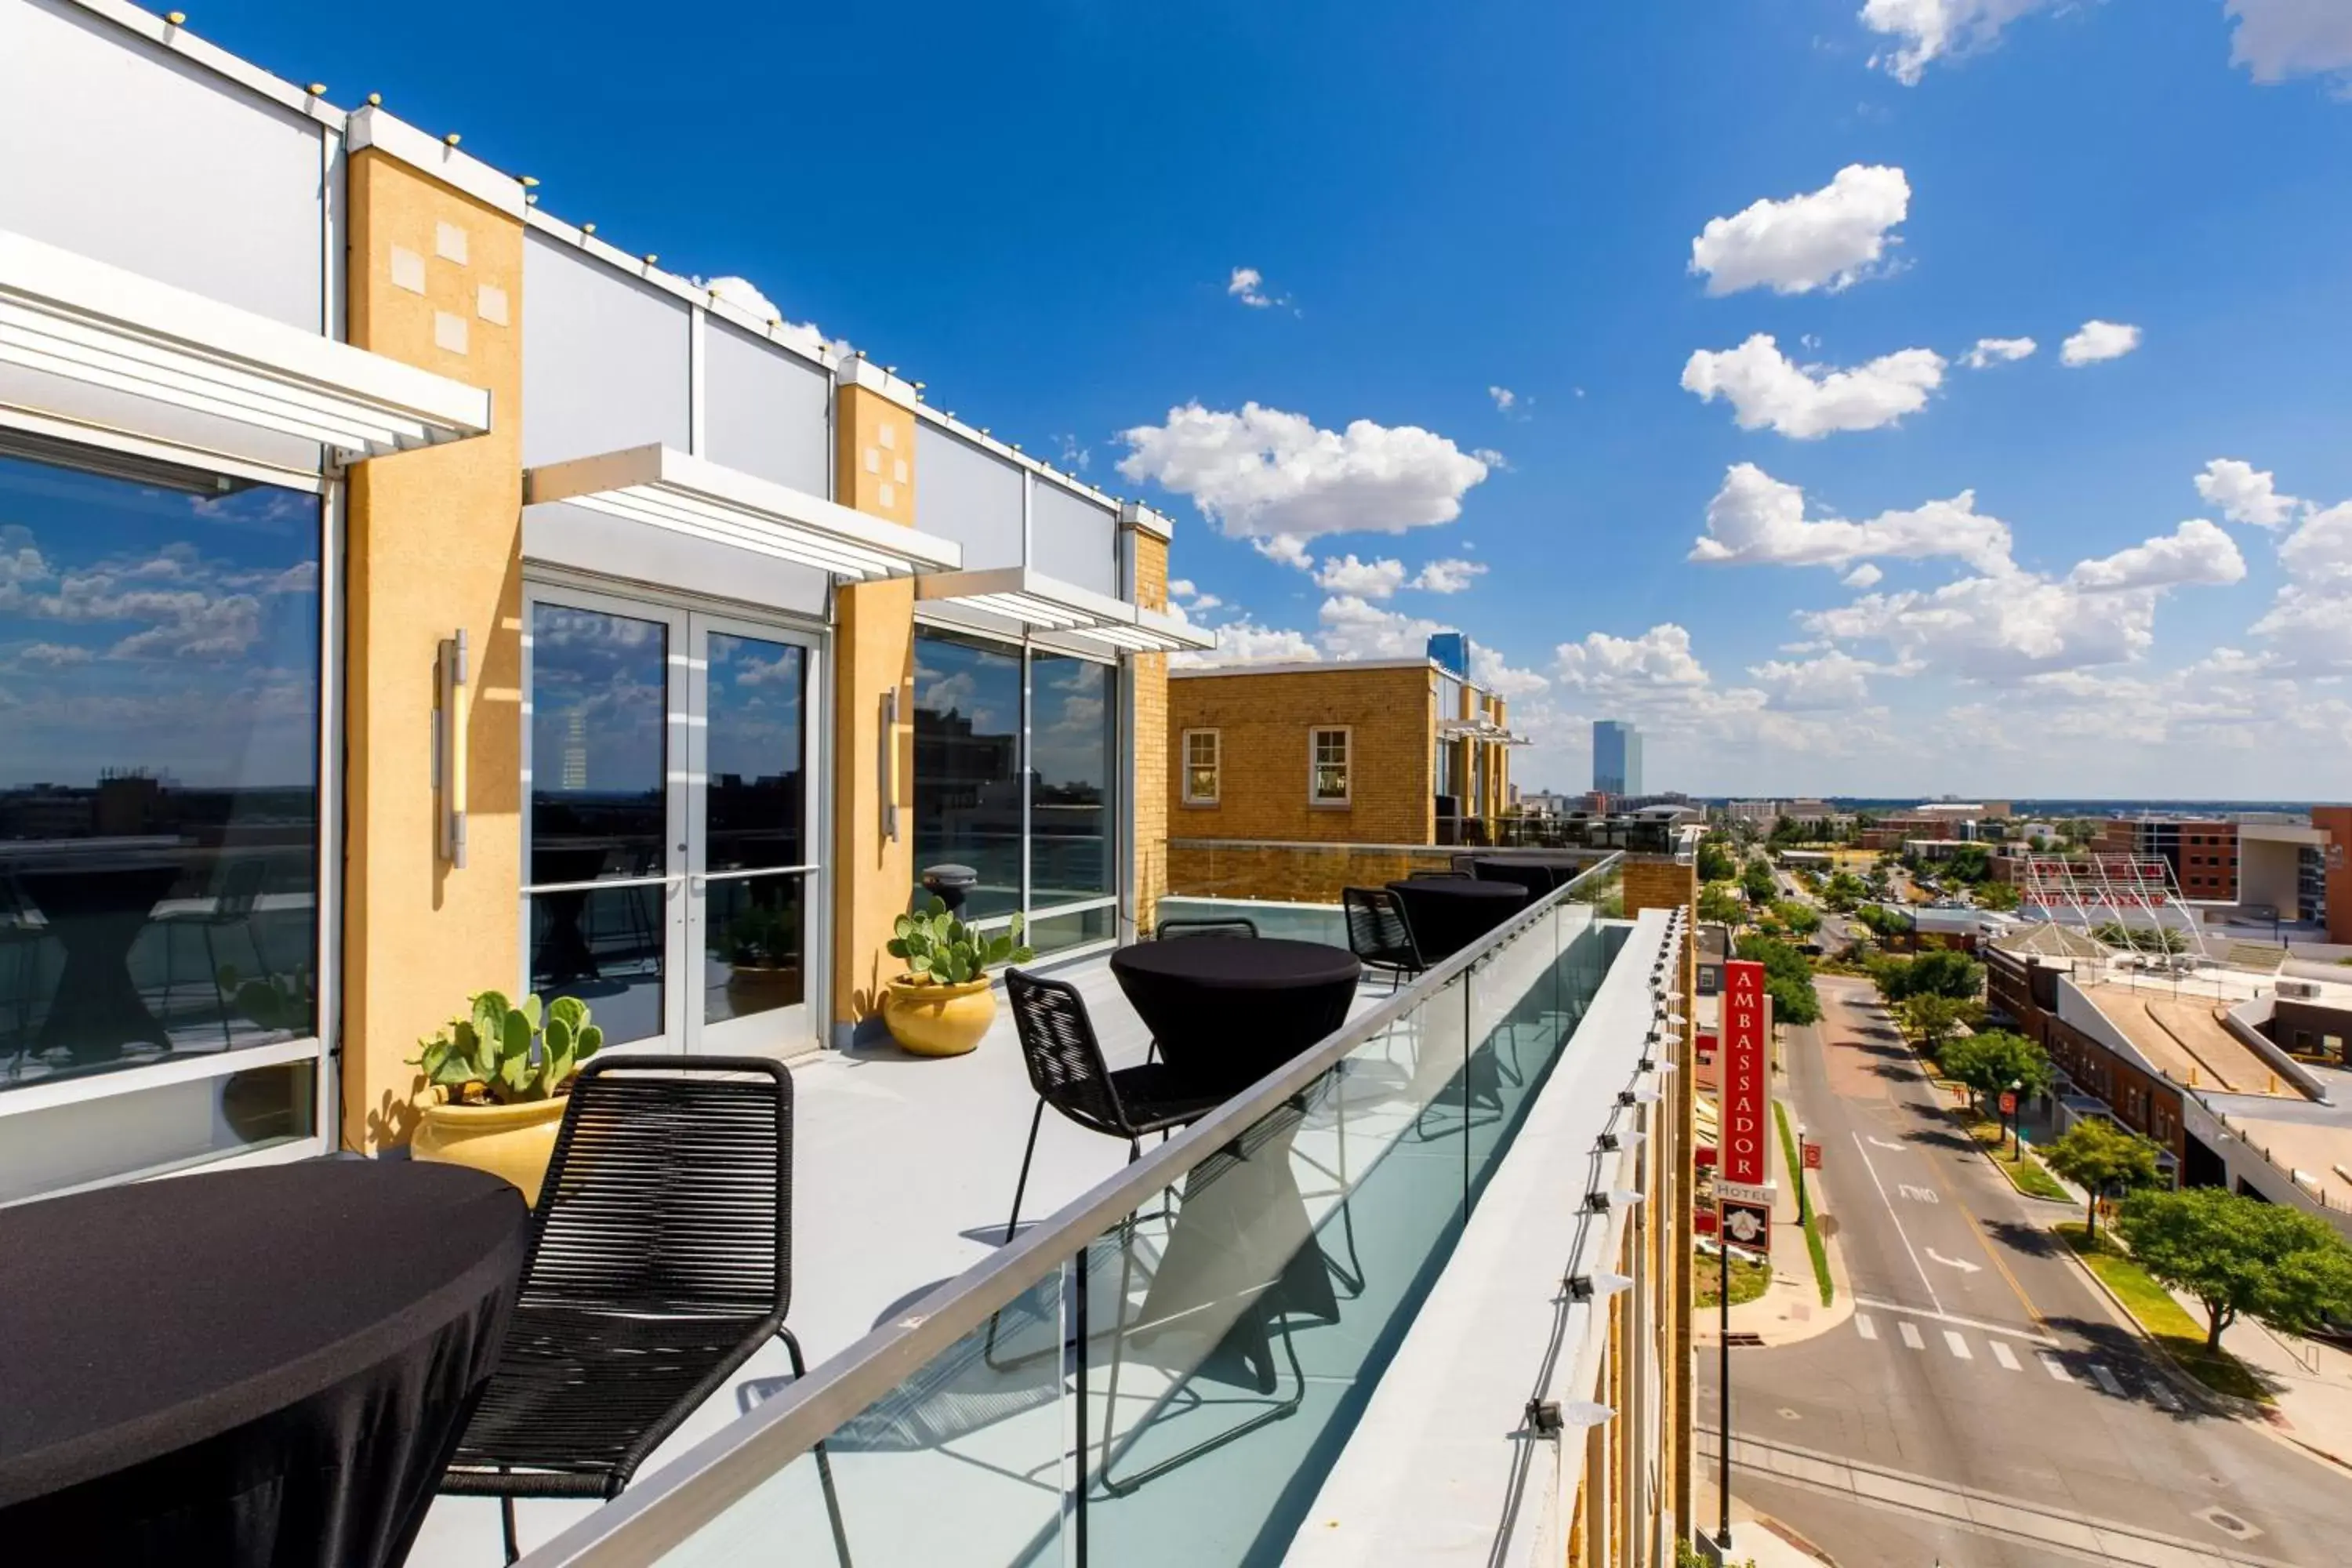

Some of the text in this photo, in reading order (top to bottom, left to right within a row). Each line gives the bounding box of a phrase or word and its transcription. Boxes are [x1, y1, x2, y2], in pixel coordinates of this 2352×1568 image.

[1734, 971, 1754, 1175] AMBASSADOR
[1718, 1185, 1771, 1202] HOTEL
[1898, 1184, 1939, 1203] ONLY
